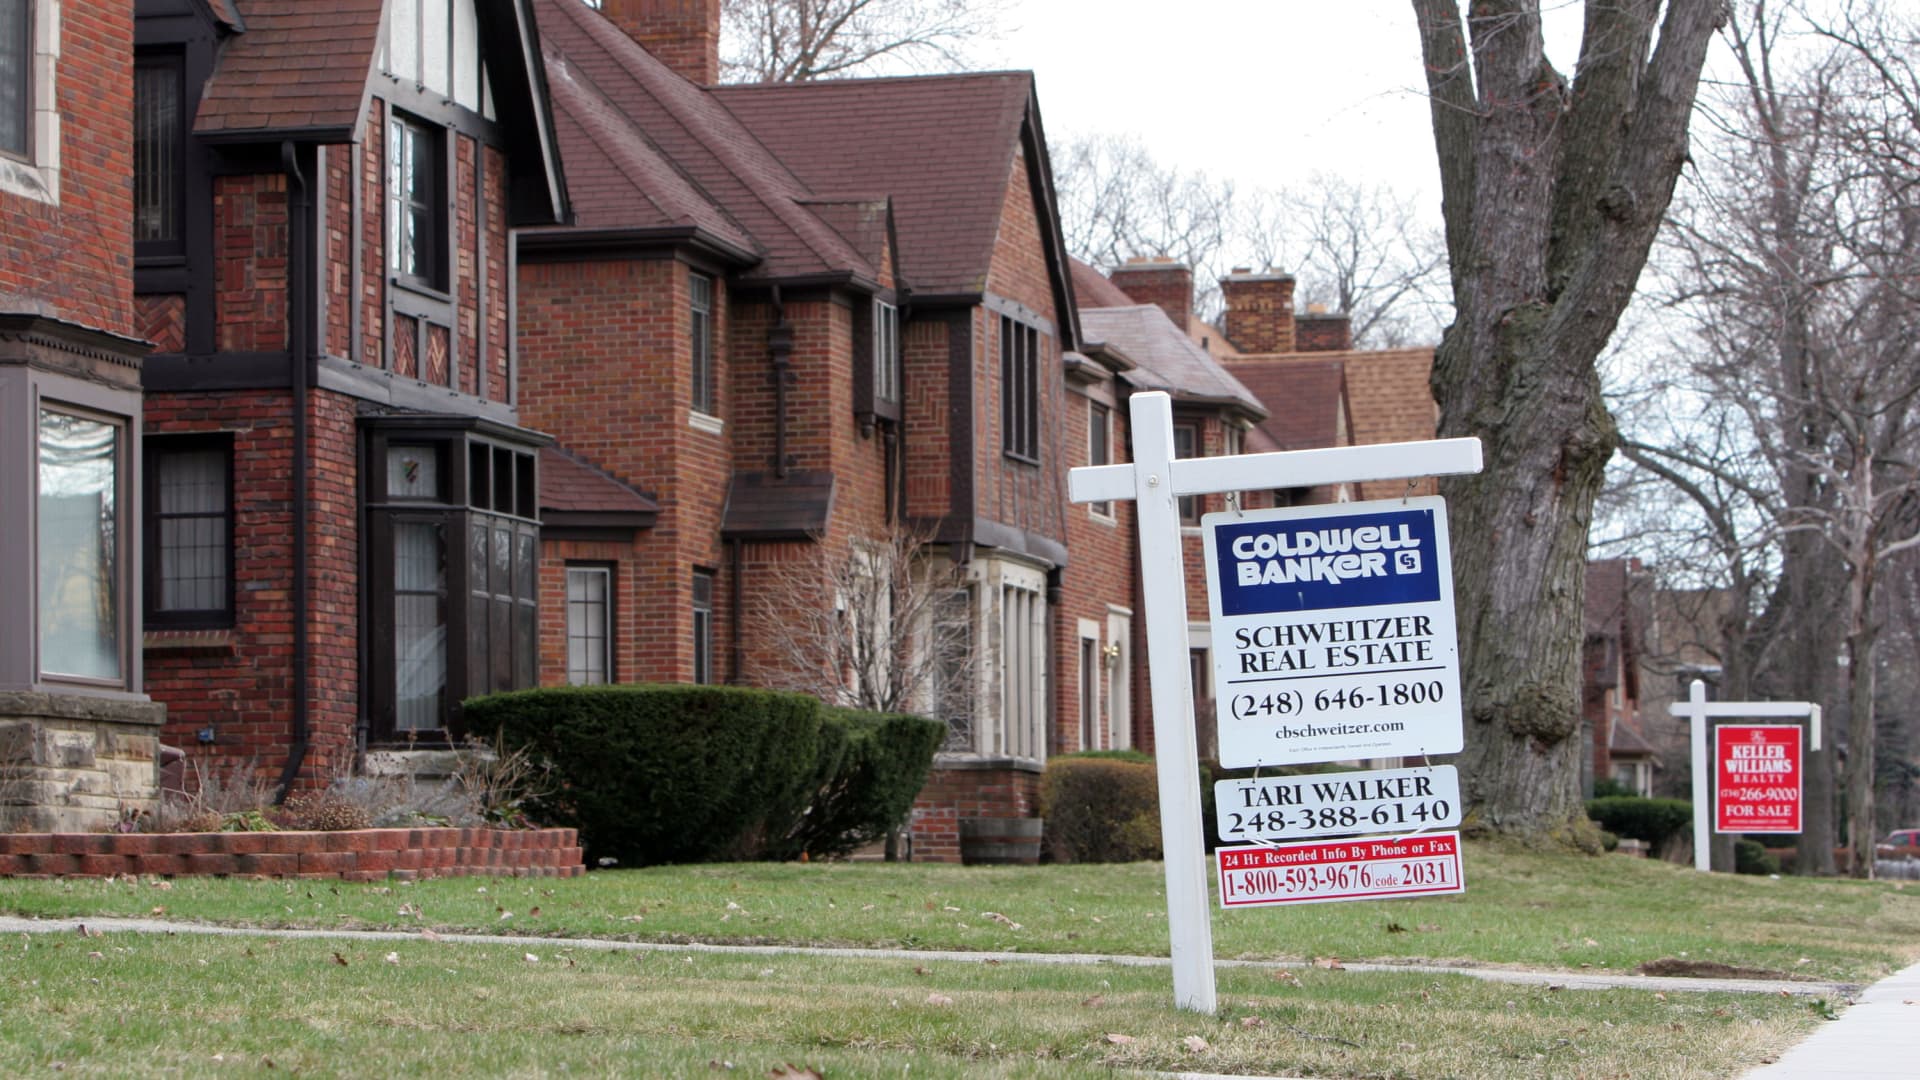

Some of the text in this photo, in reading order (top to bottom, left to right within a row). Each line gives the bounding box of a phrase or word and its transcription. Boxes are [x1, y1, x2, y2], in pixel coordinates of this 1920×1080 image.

[1232, 524, 1421, 560] COLDWELL
[1237, 552, 1388, 587] BANKER
[1235, 615, 1434, 649] SCHWEITZER
[1239, 640, 1434, 674] REAL ESTATE
[1231, 680, 1443, 720] (248) 646-1800
[1275, 720, 1404, 739] cbschweitzer.com
[1725, 759, 1792, 773] WILLIAMS
[1732, 745, 1785, 759] KELLER
[1238, 776, 1434, 808] TARI WALKER
[1733, 774, 1784, 783] REALTY
[1739, 787, 1797, 801] 266-9000
[1228, 799, 1450, 833] 248-388-6140
[1726, 805, 1792, 817] FOR SALE
[1225, 840, 1451, 866] 24 Hr Recorded Info By Phone or Fax
[1226, 861, 1447, 896] 1-800-593-9676 code 2031
